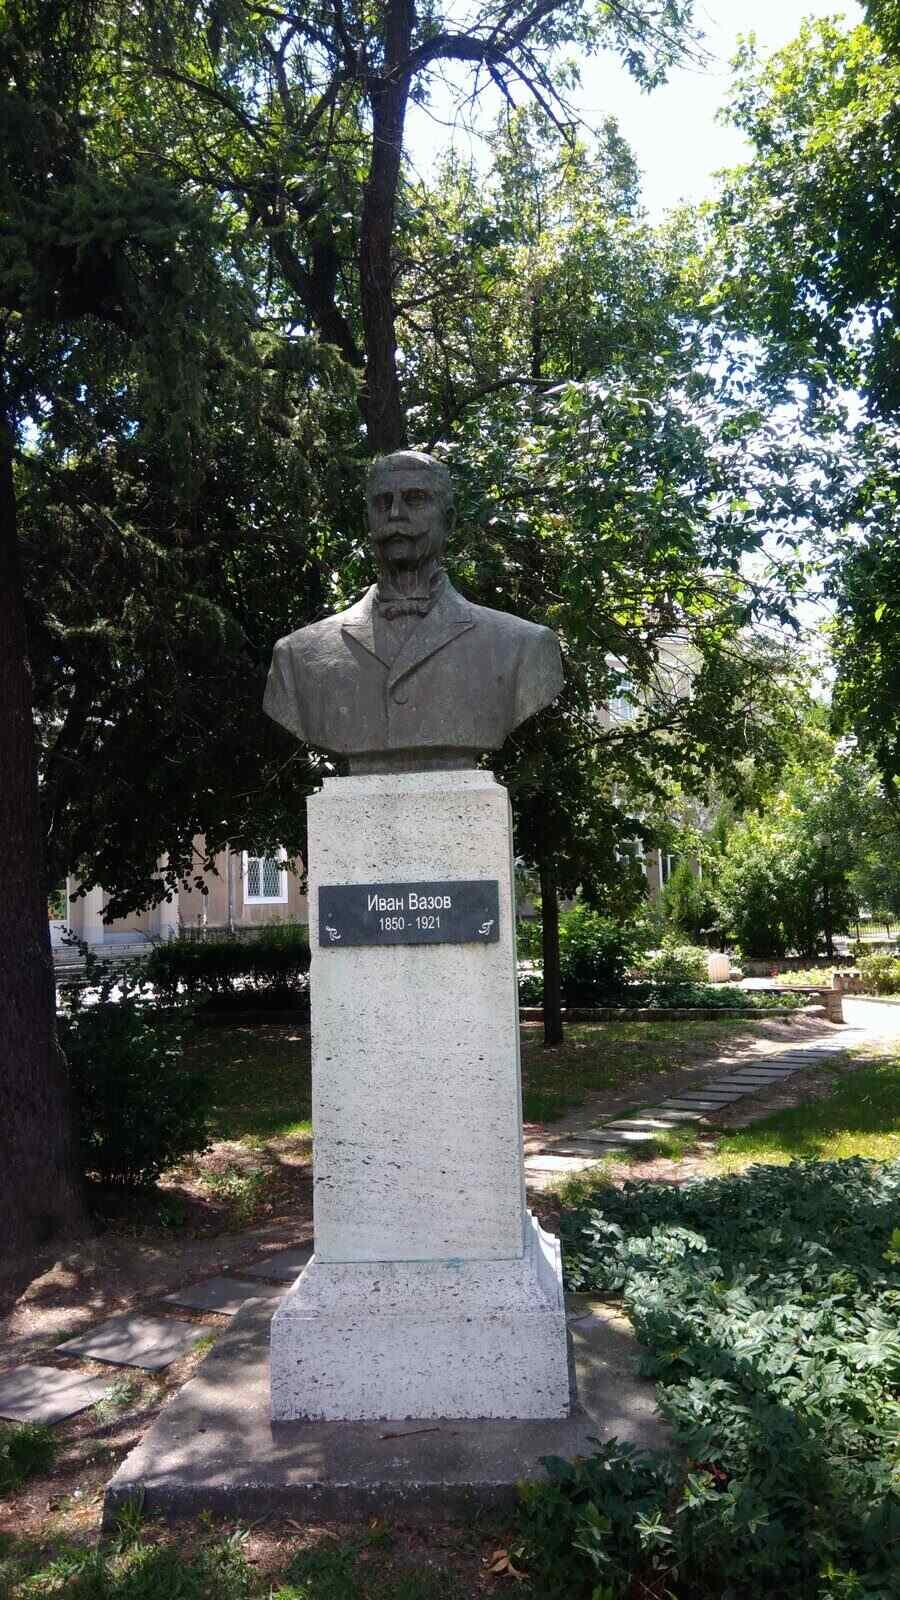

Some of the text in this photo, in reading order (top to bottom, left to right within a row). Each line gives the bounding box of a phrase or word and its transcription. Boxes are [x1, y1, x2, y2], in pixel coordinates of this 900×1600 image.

[367, 893, 452, 911] Иван Вазов
[379, 916, 405, 930] 1850
[415, 915, 441, 930] 1921
